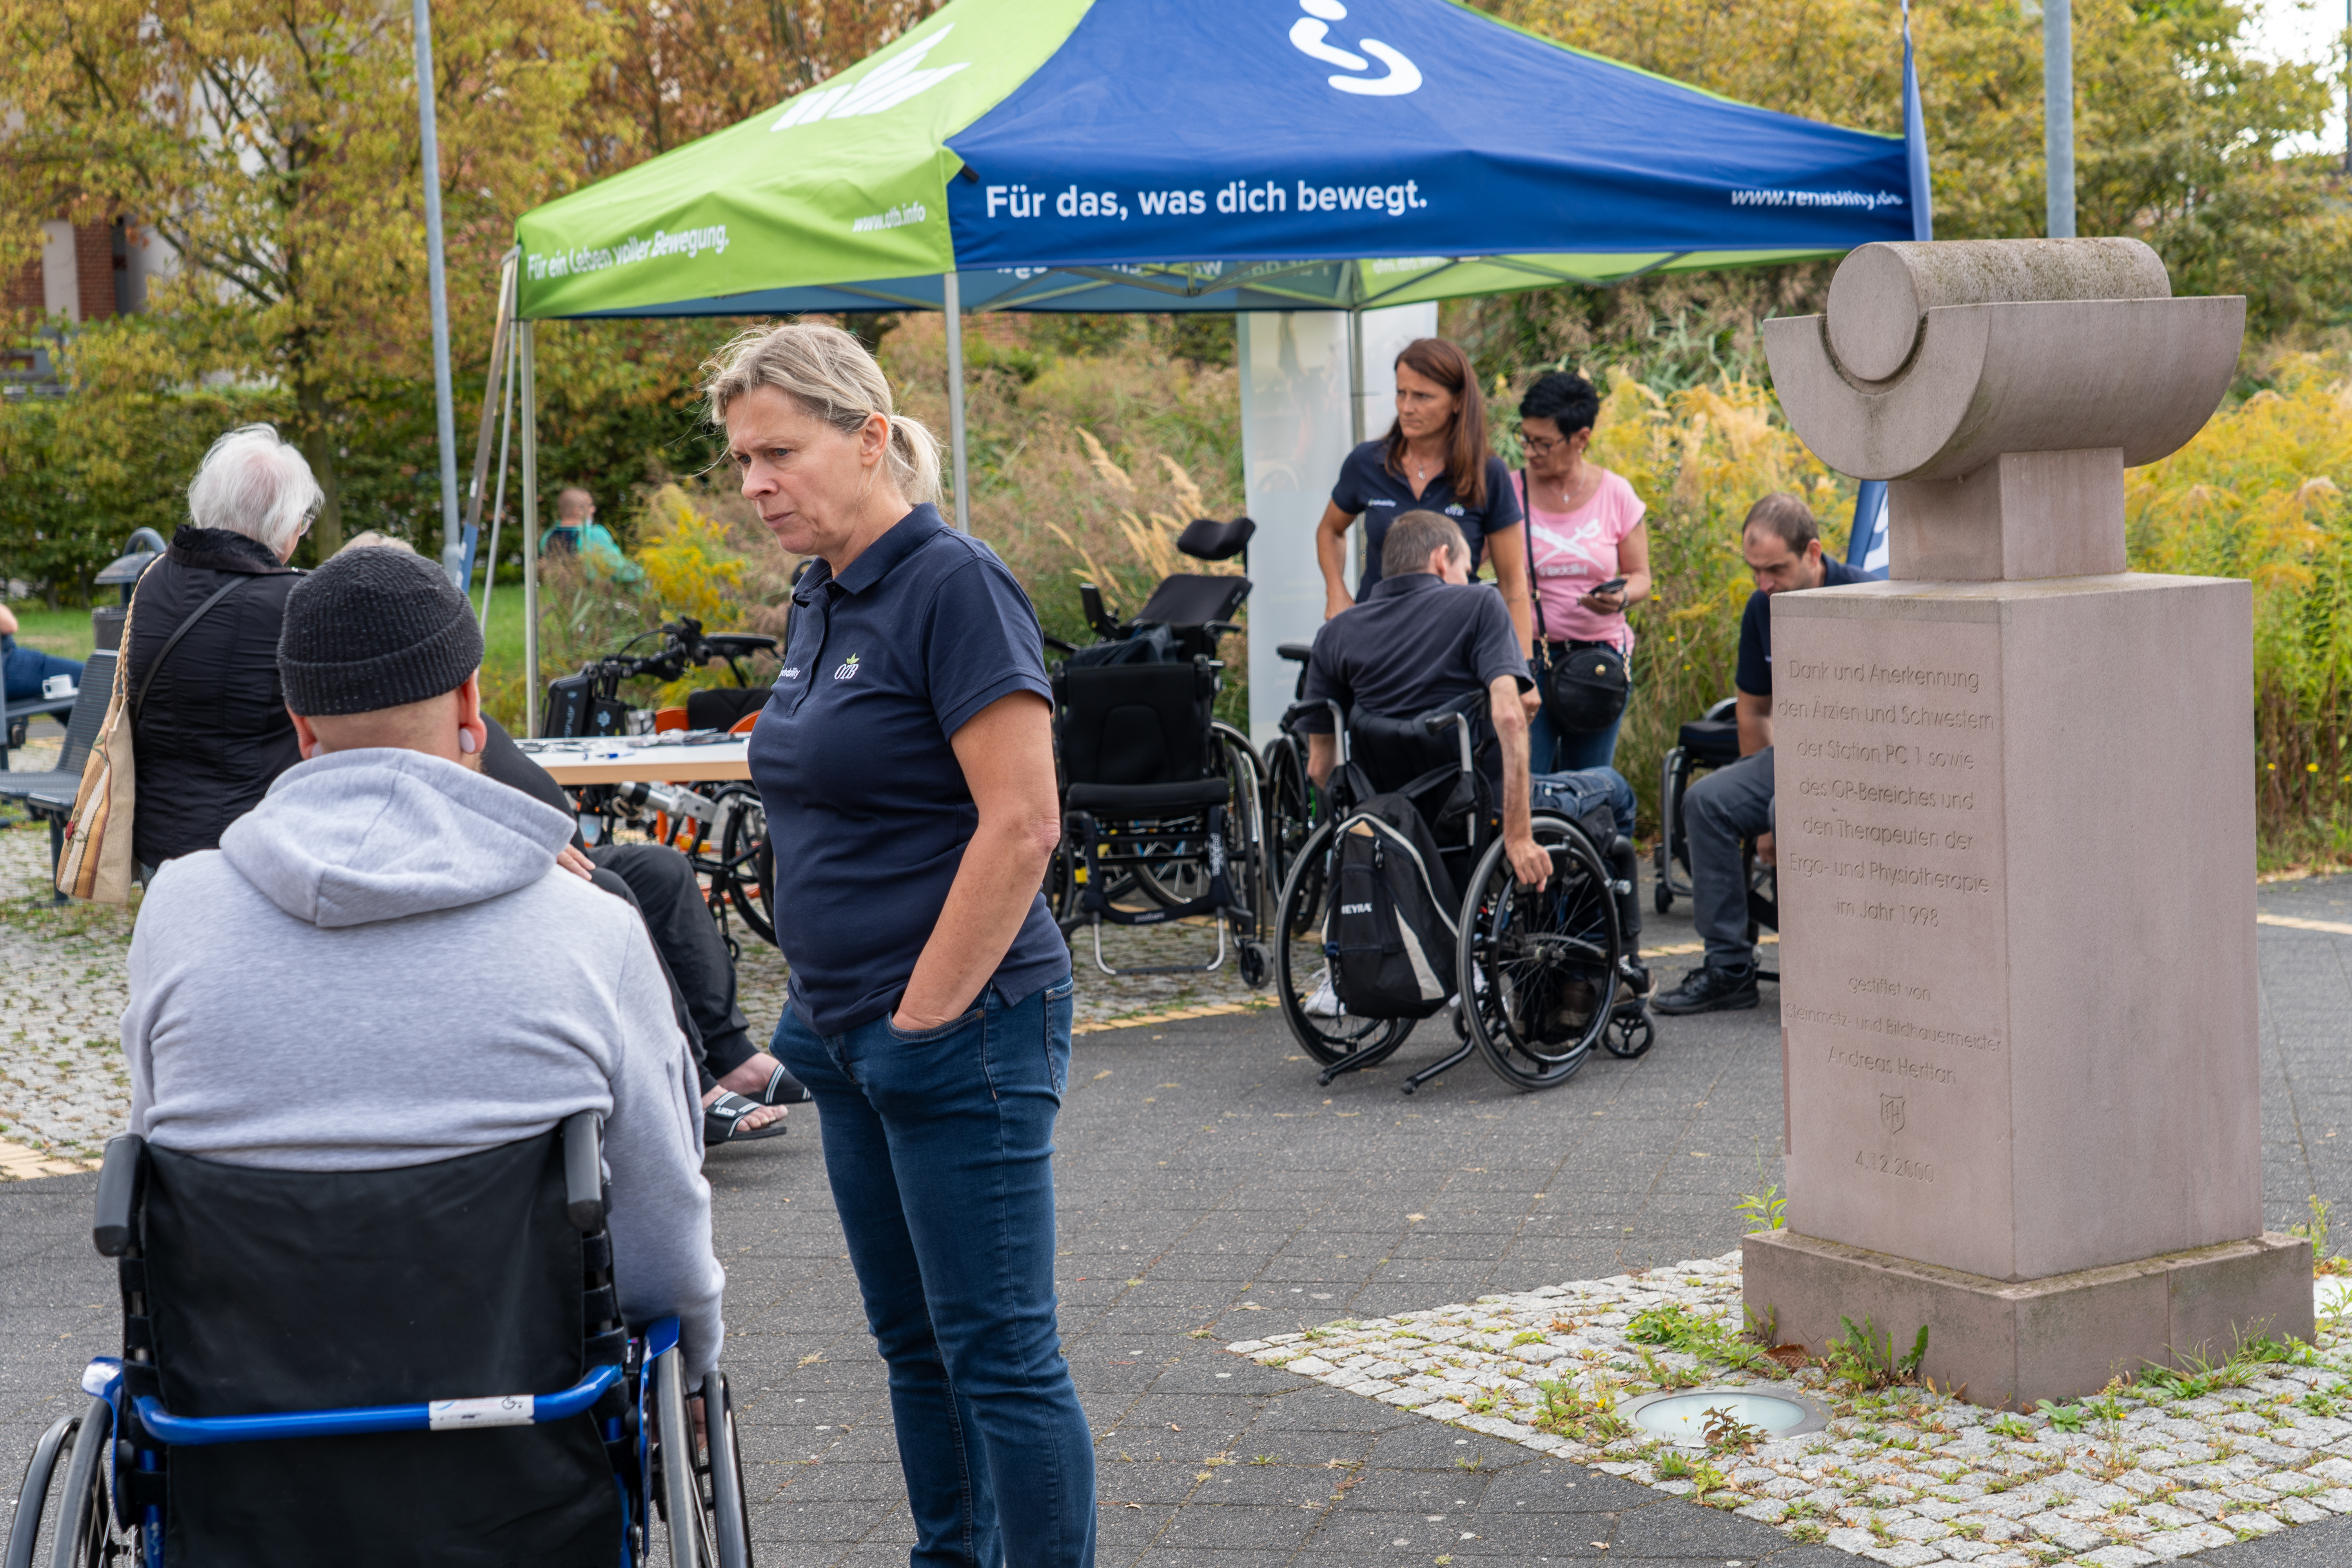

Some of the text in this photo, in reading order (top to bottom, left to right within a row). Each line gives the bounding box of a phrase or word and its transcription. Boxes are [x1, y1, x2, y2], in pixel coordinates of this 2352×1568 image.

[986, 179, 1428, 221] Für das, was dich bewegt.
[527, 223, 730, 281] Für ein Leben voller Bewegung.
[834, 663, 859, 680] OTB
[1790, 661, 1979, 693] Dank und Anerkennung
[1778, 697, 1993, 731] den Ärzten und Schwestern
[1797, 740, 1975, 770] der Station PC 1 sowie
[1800, 779, 1974, 811] des OP-Bereiches und
[1803, 817, 1973, 850] den Therapeuten der
[1790, 854, 1989, 895] Ergo- und Physiotherapie
[1836, 898, 1939, 928] im Jahr 1998
[1848, 976, 1931, 1002] gestiftet von
[1786, 1004, 2002, 1053] Steinmetz- und Bildhauermeister
[1828, 1046, 1892, 1074] Andreas
[1855, 1151, 1934, 1183] 4.12.2000
